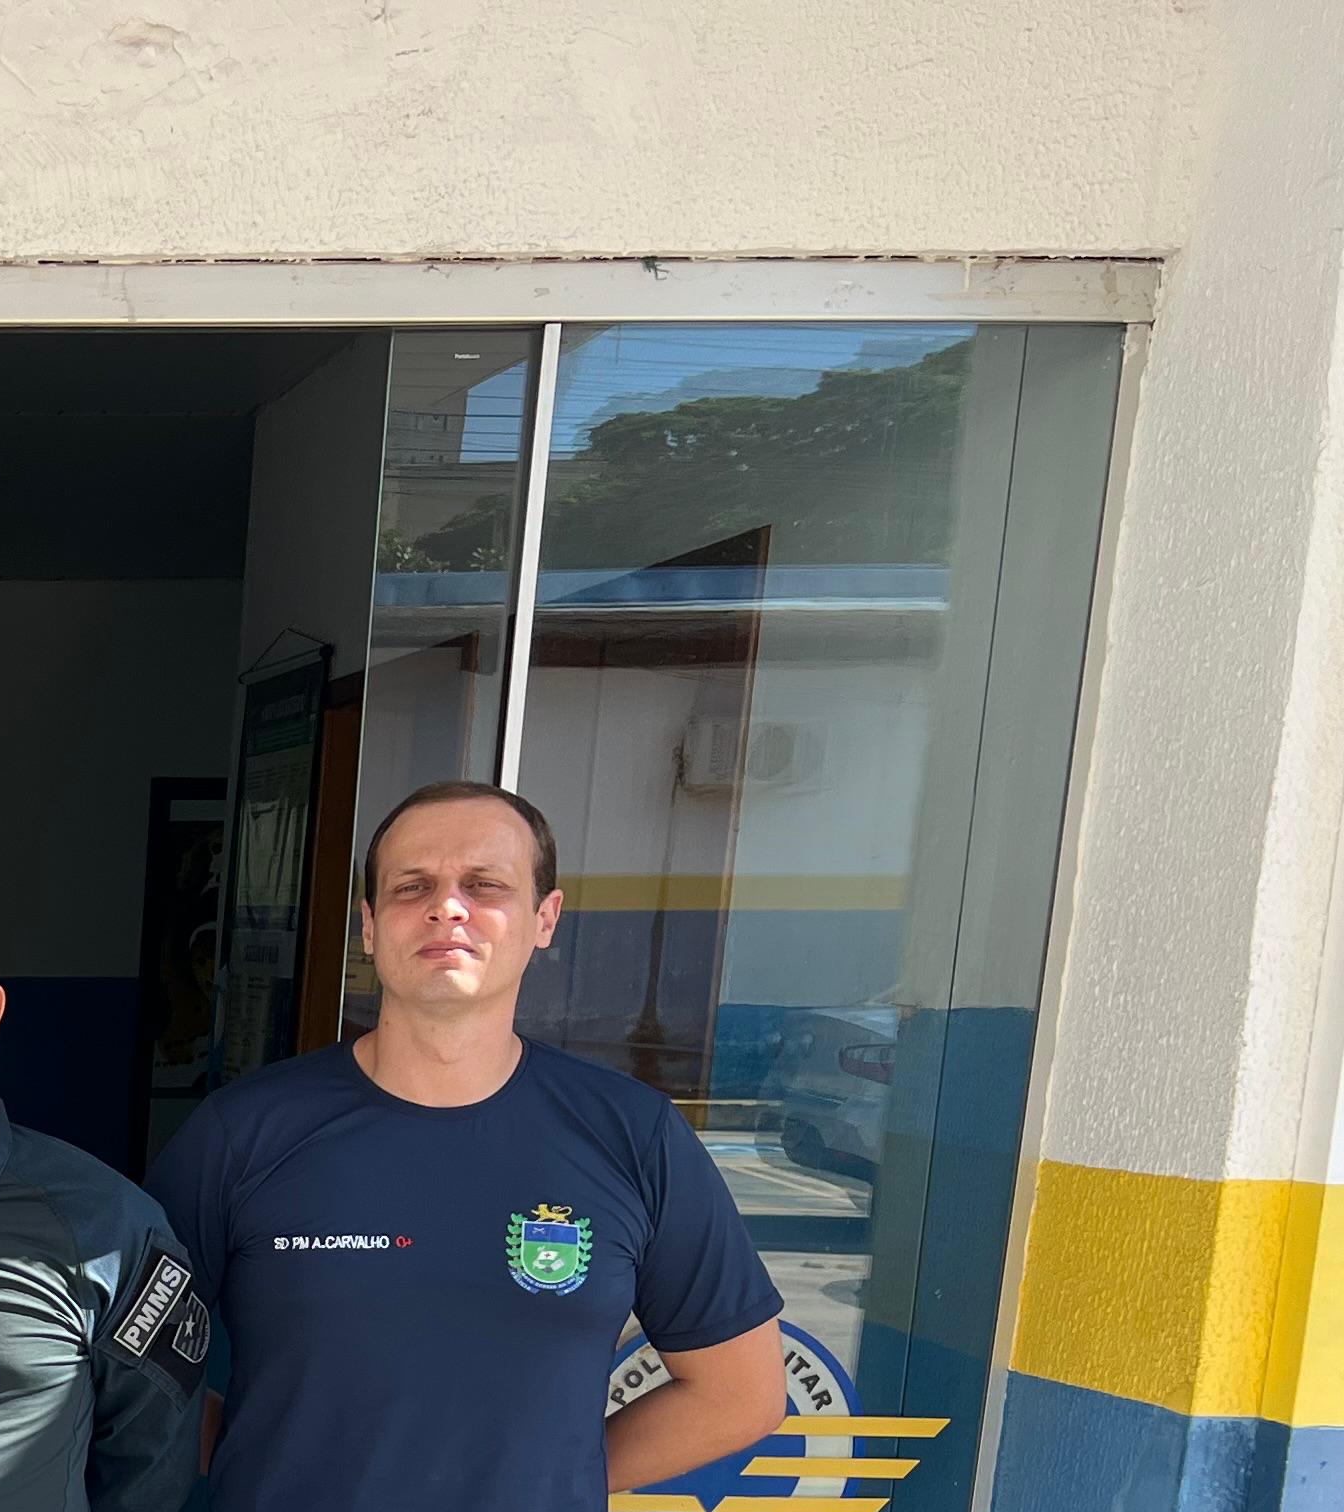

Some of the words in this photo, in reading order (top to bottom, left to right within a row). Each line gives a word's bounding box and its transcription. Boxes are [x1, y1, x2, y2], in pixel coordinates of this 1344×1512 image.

[123, 1265, 181, 1349] PMMS
[610, 1359, 661, 1406] POL
[784, 1351, 833, 1411] ITAR
